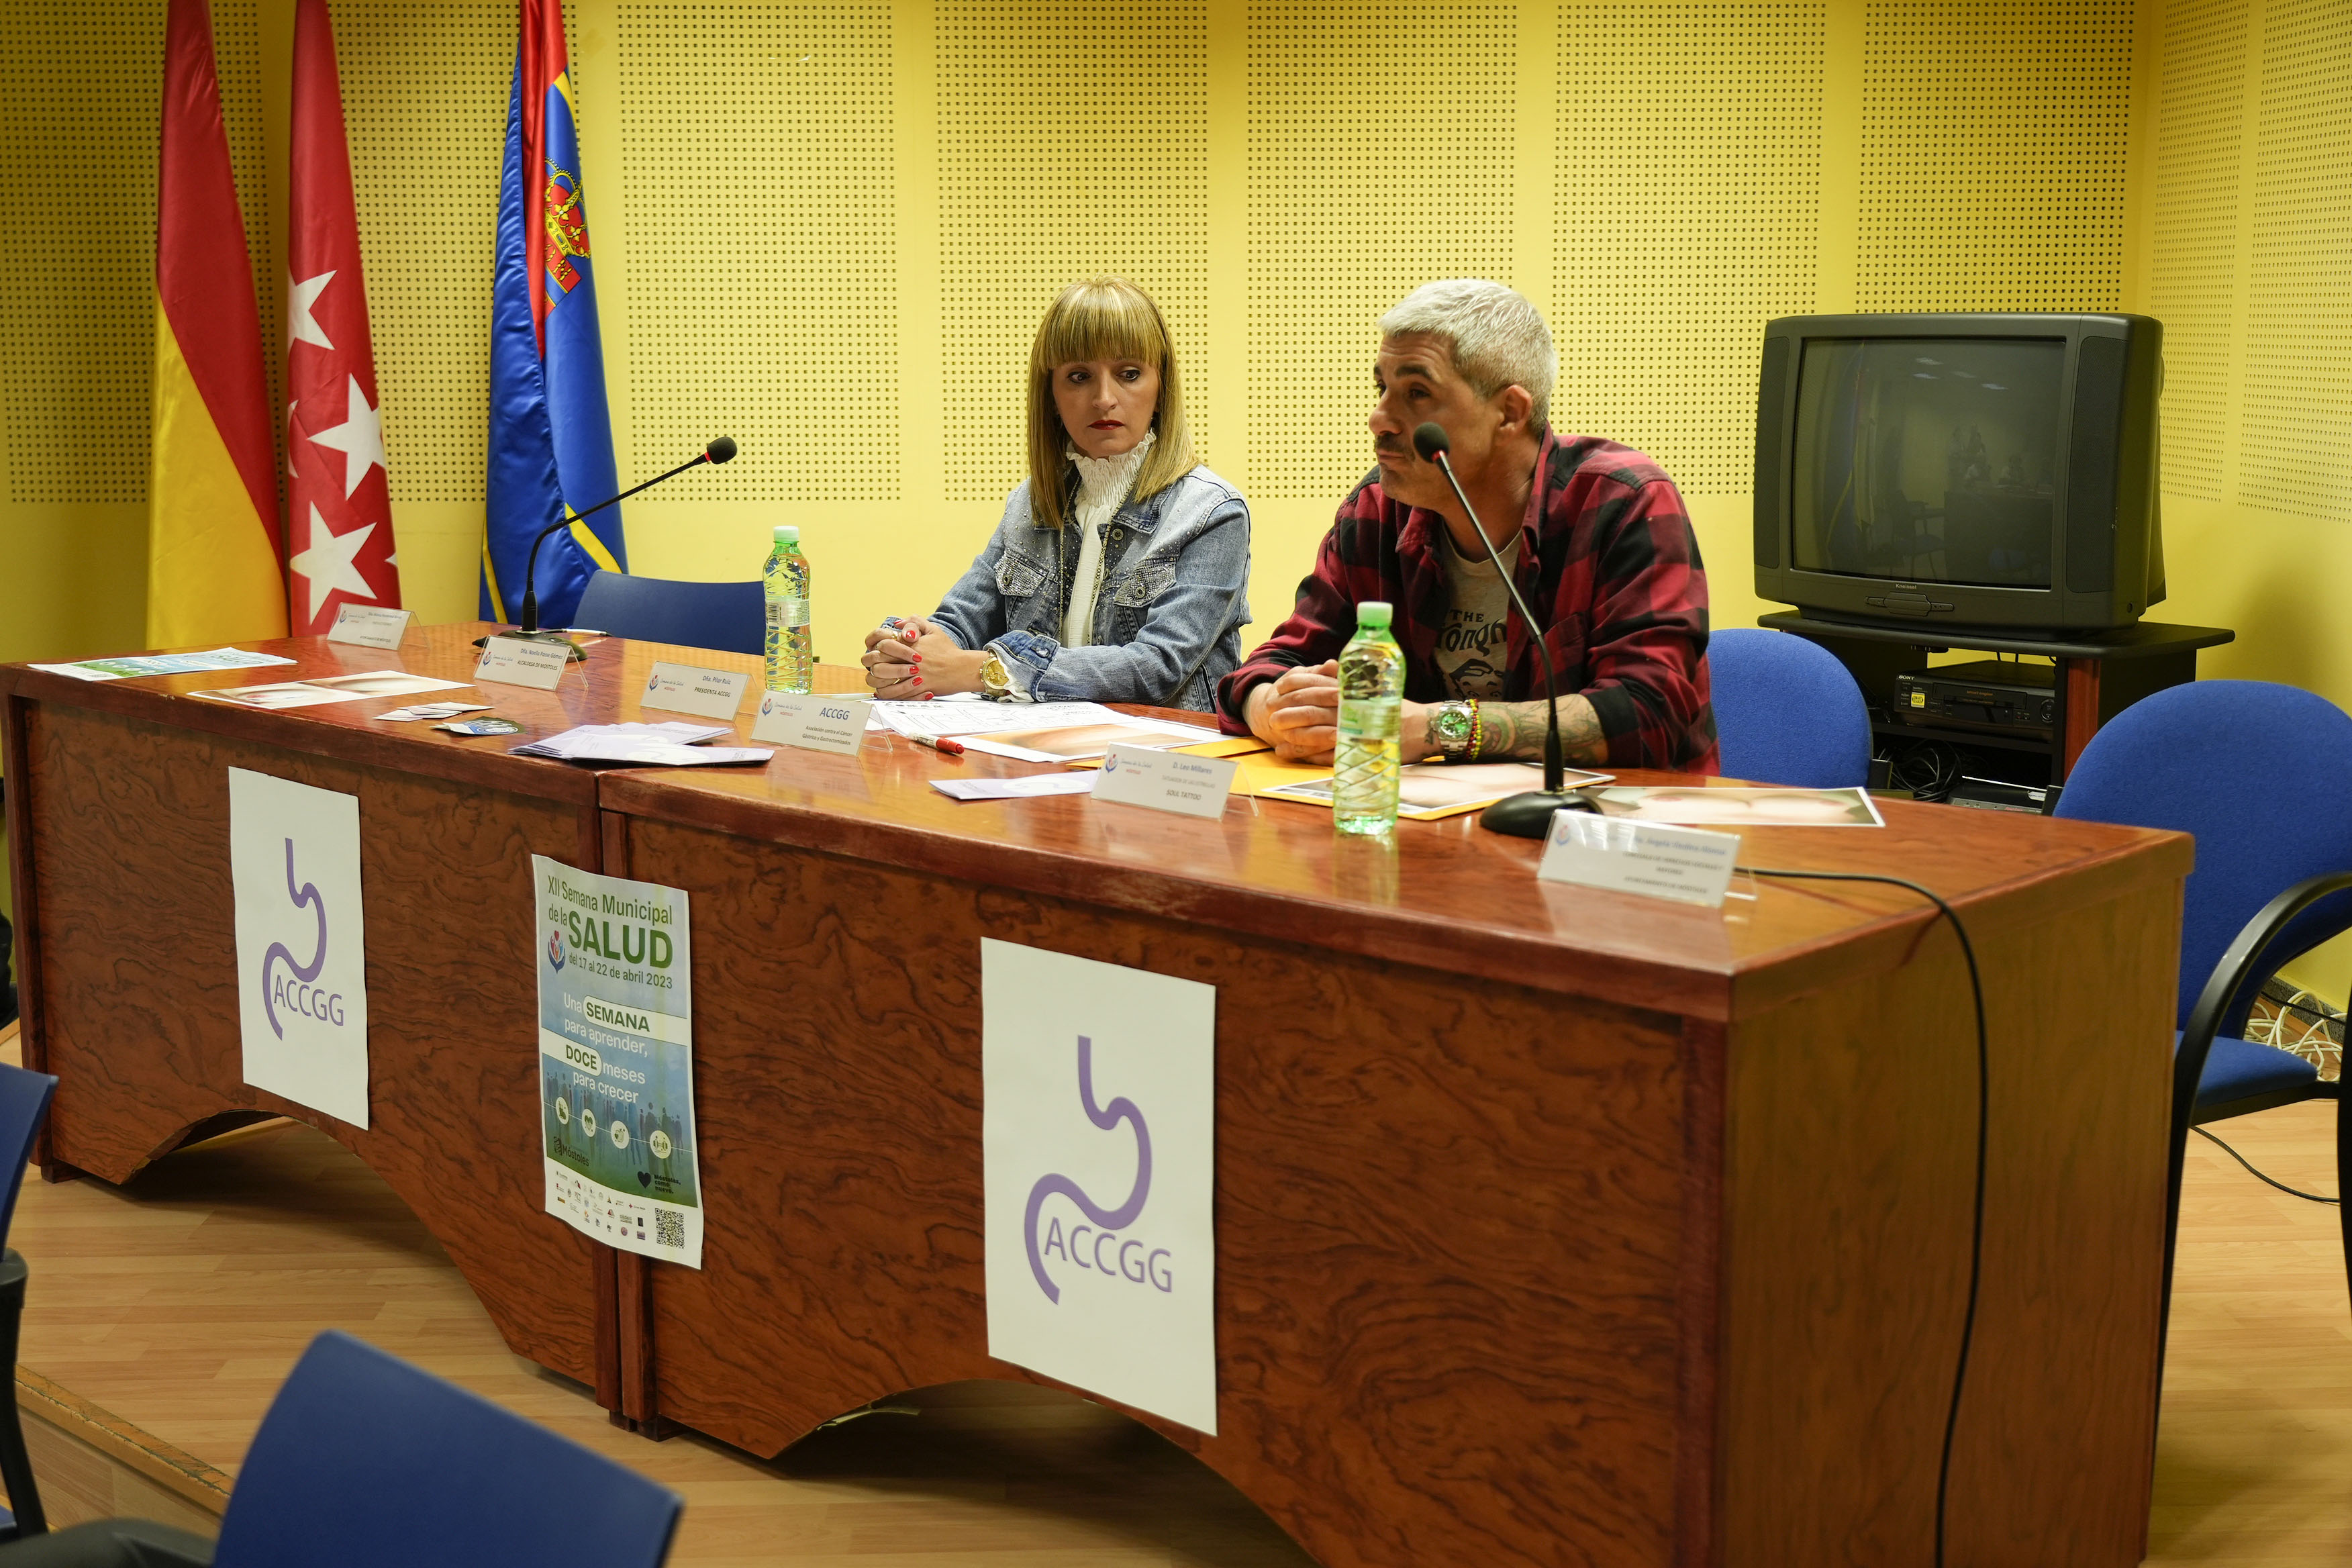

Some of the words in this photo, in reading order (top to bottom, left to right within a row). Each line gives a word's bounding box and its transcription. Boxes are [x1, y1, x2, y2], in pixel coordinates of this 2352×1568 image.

[1451, 609, 1483, 622] THE
[694, 687, 717, 695] PRESIDENTA
[805, 725, 824, 733] Asociación
[819, 707, 850, 720] ACCGG
[1180, 763, 1189, 771] Leo
[1166, 789, 1180, 797] SOUL
[1181, 791, 1202, 801] TATTOO
[548, 875, 560, 897] XII
[562, 881, 598, 912] Semana
[603, 893, 673, 926] Municipal
[548, 903, 558, 922] de
[560, 908, 567, 926] la
[569, 910, 673, 969] SALUD
[569, 952, 578, 966] del
[579, 957, 587, 969] 17
[589, 961, 595, 972] al
[597, 963, 607, 976] 22
[609, 966, 620, 979] de
[623, 969, 644, 983] abril
[646, 973, 673, 989] 2023
[274, 974, 344, 1026] ACCGG
[564, 992, 582, 1014] Una
[586, 1001, 650, 1032] SEMANA
[565, 1018, 587, 1037] para
[589, 1028, 648, 1058] aprender,
[566, 1044, 597, 1070] DOCE
[603, 1062, 646, 1084] meses
[573, 1072, 595, 1090] para
[598, 1082, 639, 1104] crecer
[562, 1144, 589, 1167] Móstoles
[1044, 1216, 1172, 1293] ACCGG
